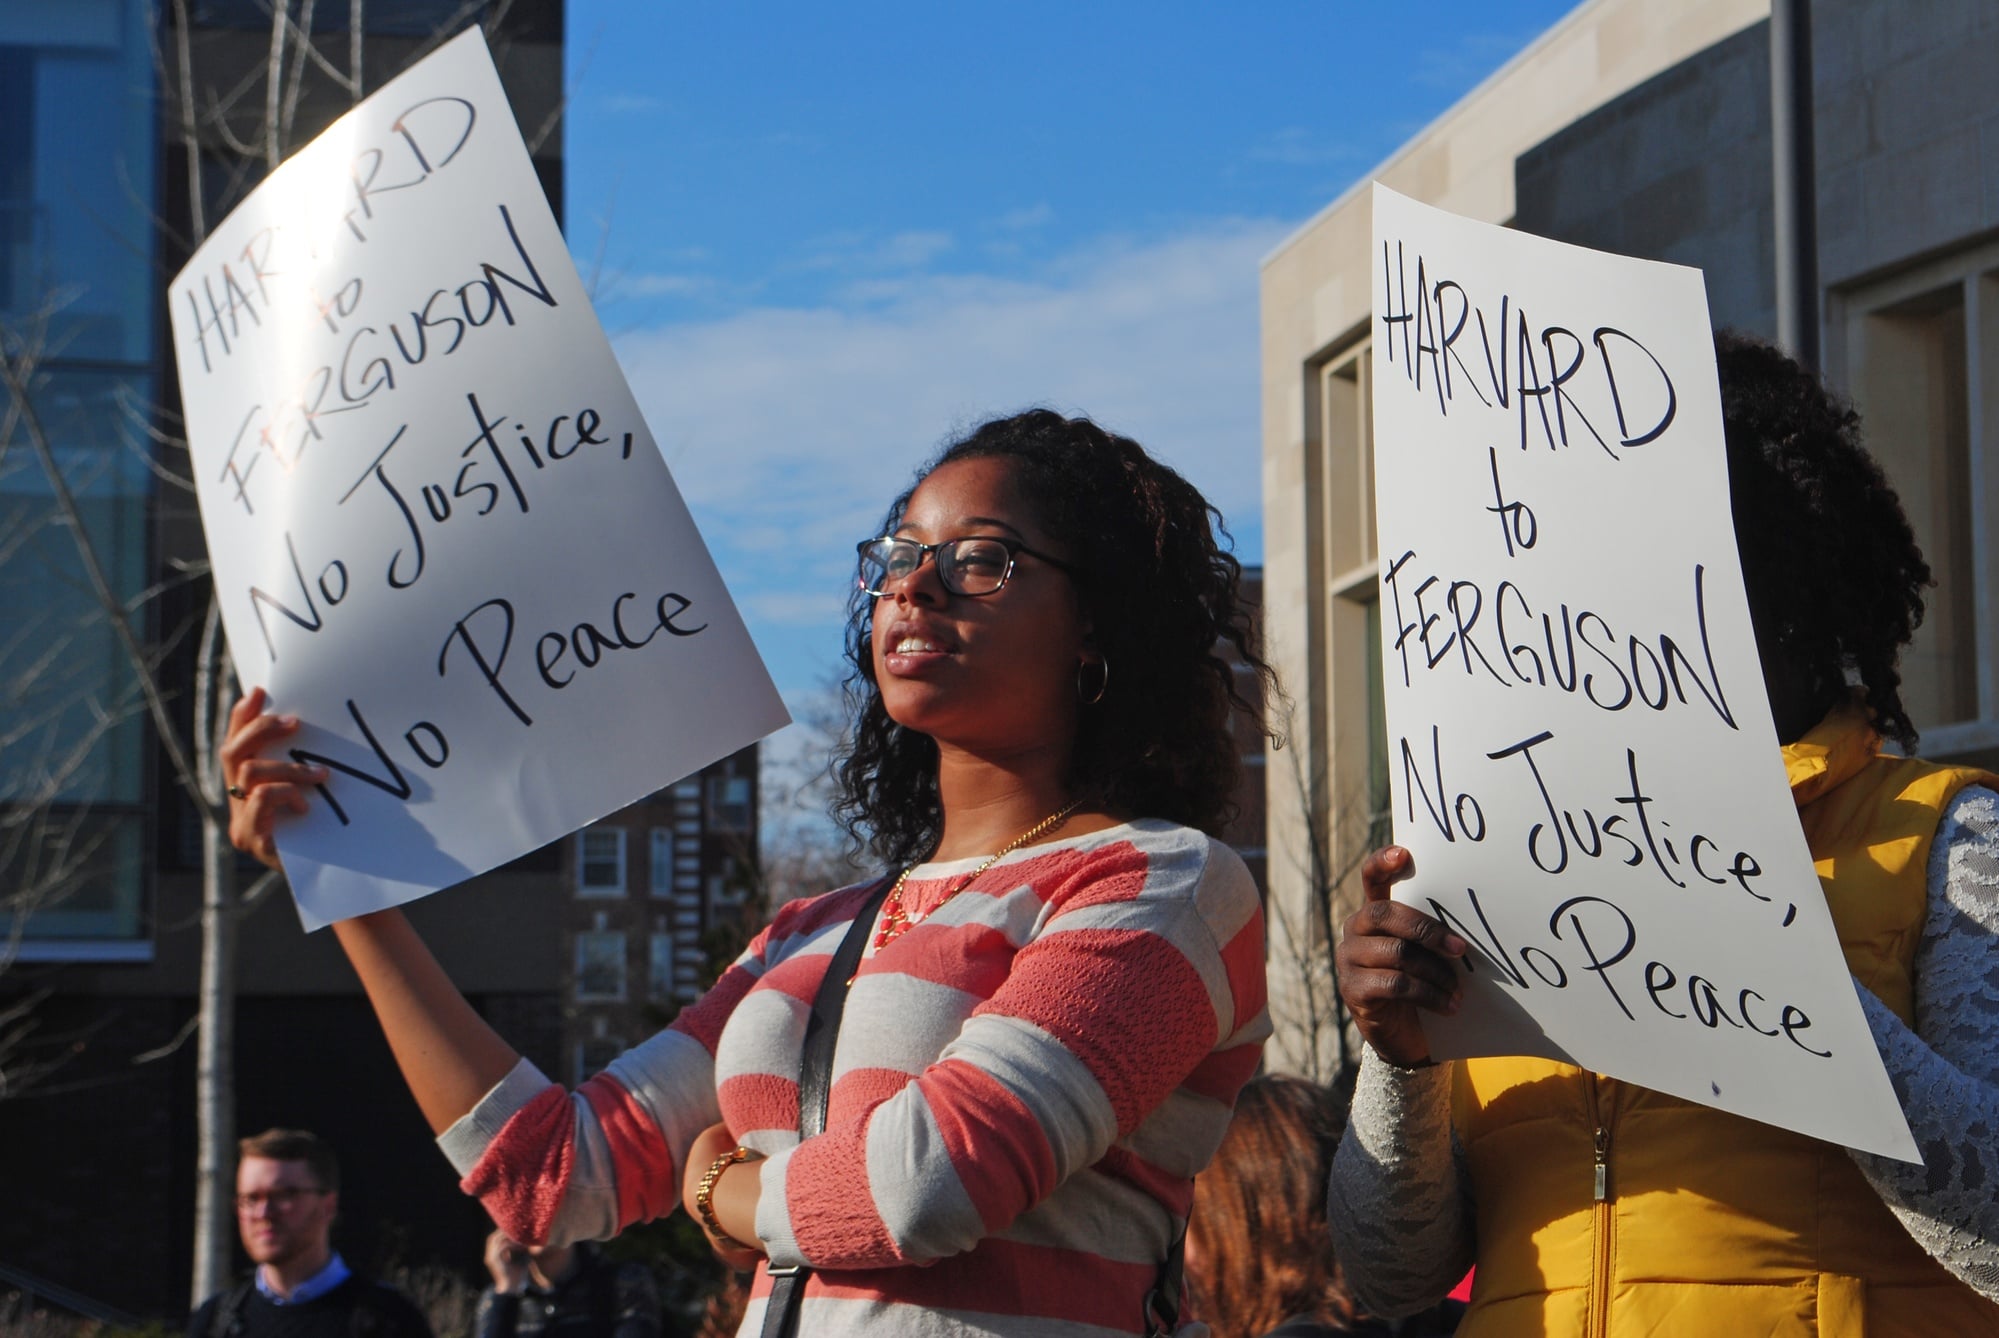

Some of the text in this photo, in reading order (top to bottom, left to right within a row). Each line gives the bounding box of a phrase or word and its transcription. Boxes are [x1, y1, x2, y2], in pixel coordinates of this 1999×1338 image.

[187, 96, 476, 373] HARRD
[311, 278, 363, 334] to
[1381, 239, 1677, 462] HARVARD
[251, 392, 633, 662] No Justice,
[1485, 446, 1538, 558] to
[289, 597, 709, 826] No Peace
[1385, 550, 1735, 730] FERGUSON
[1400, 724, 1798, 928] No Justice,
[1425, 887, 1833, 1058] No Peace
